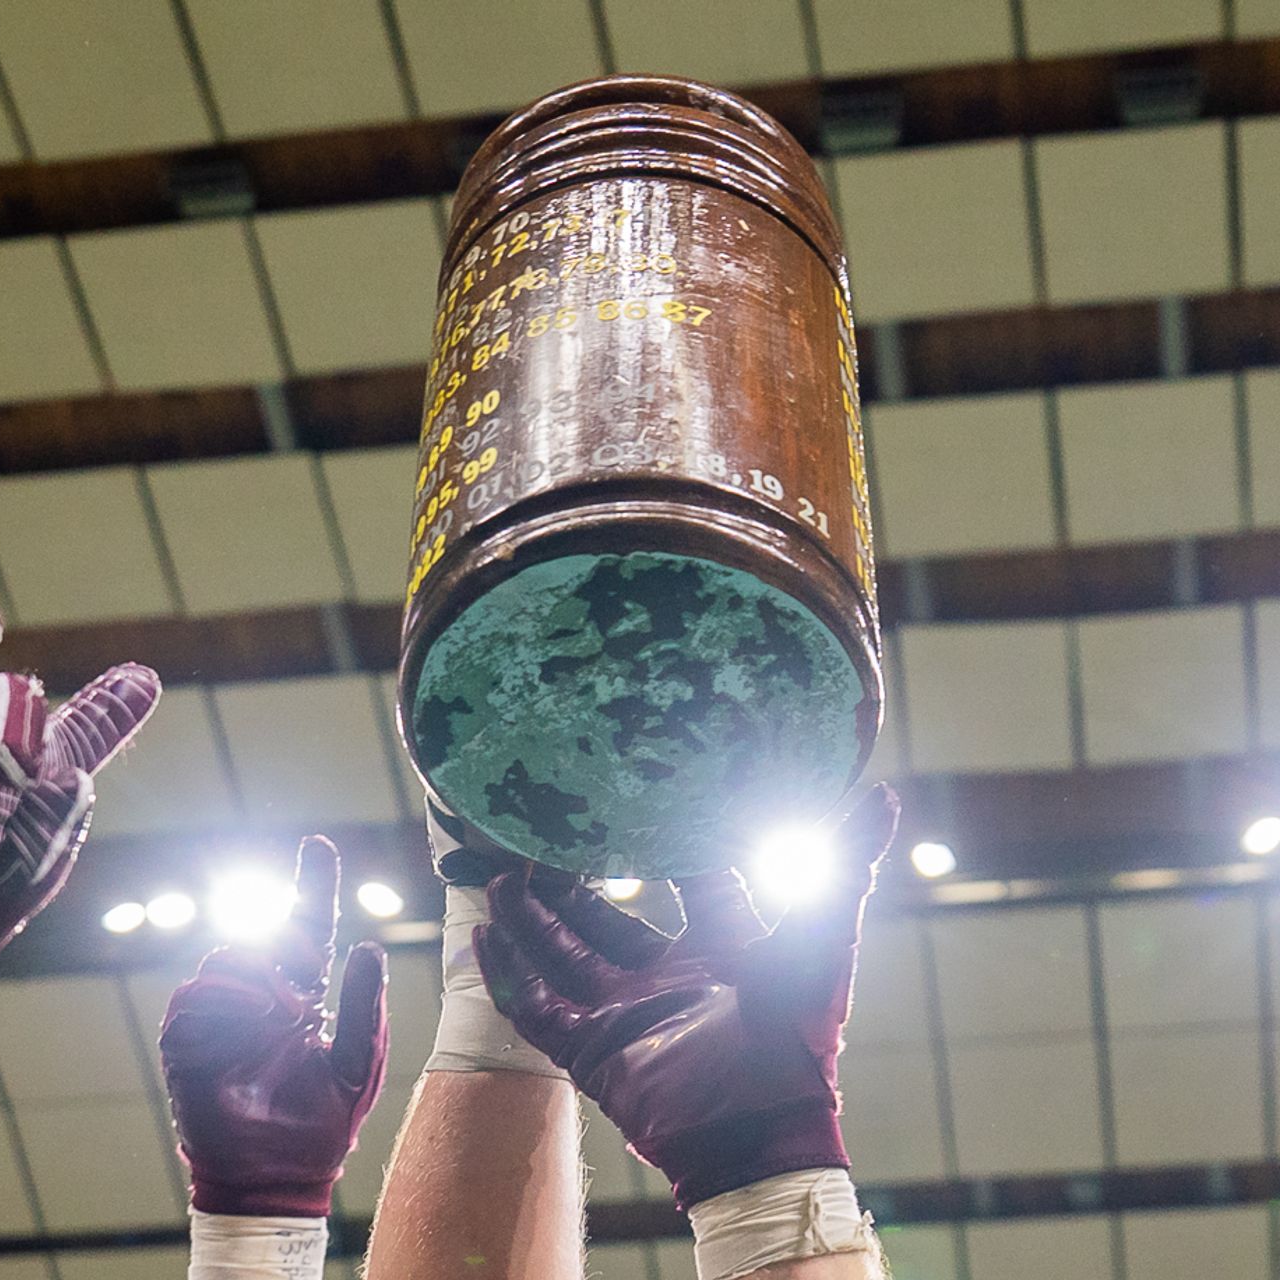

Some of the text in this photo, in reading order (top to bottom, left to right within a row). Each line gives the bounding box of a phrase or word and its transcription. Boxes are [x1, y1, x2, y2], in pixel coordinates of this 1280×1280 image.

[526, 307, 578, 338] 85
[597, 300, 649, 321] 86
[663, 300, 712, 327] 87
[466, 390, 501, 427] 90
[462, 447, 498, 485] 99
[749, 468, 784, 501] 19
[797, 496, 831, 540] 21
